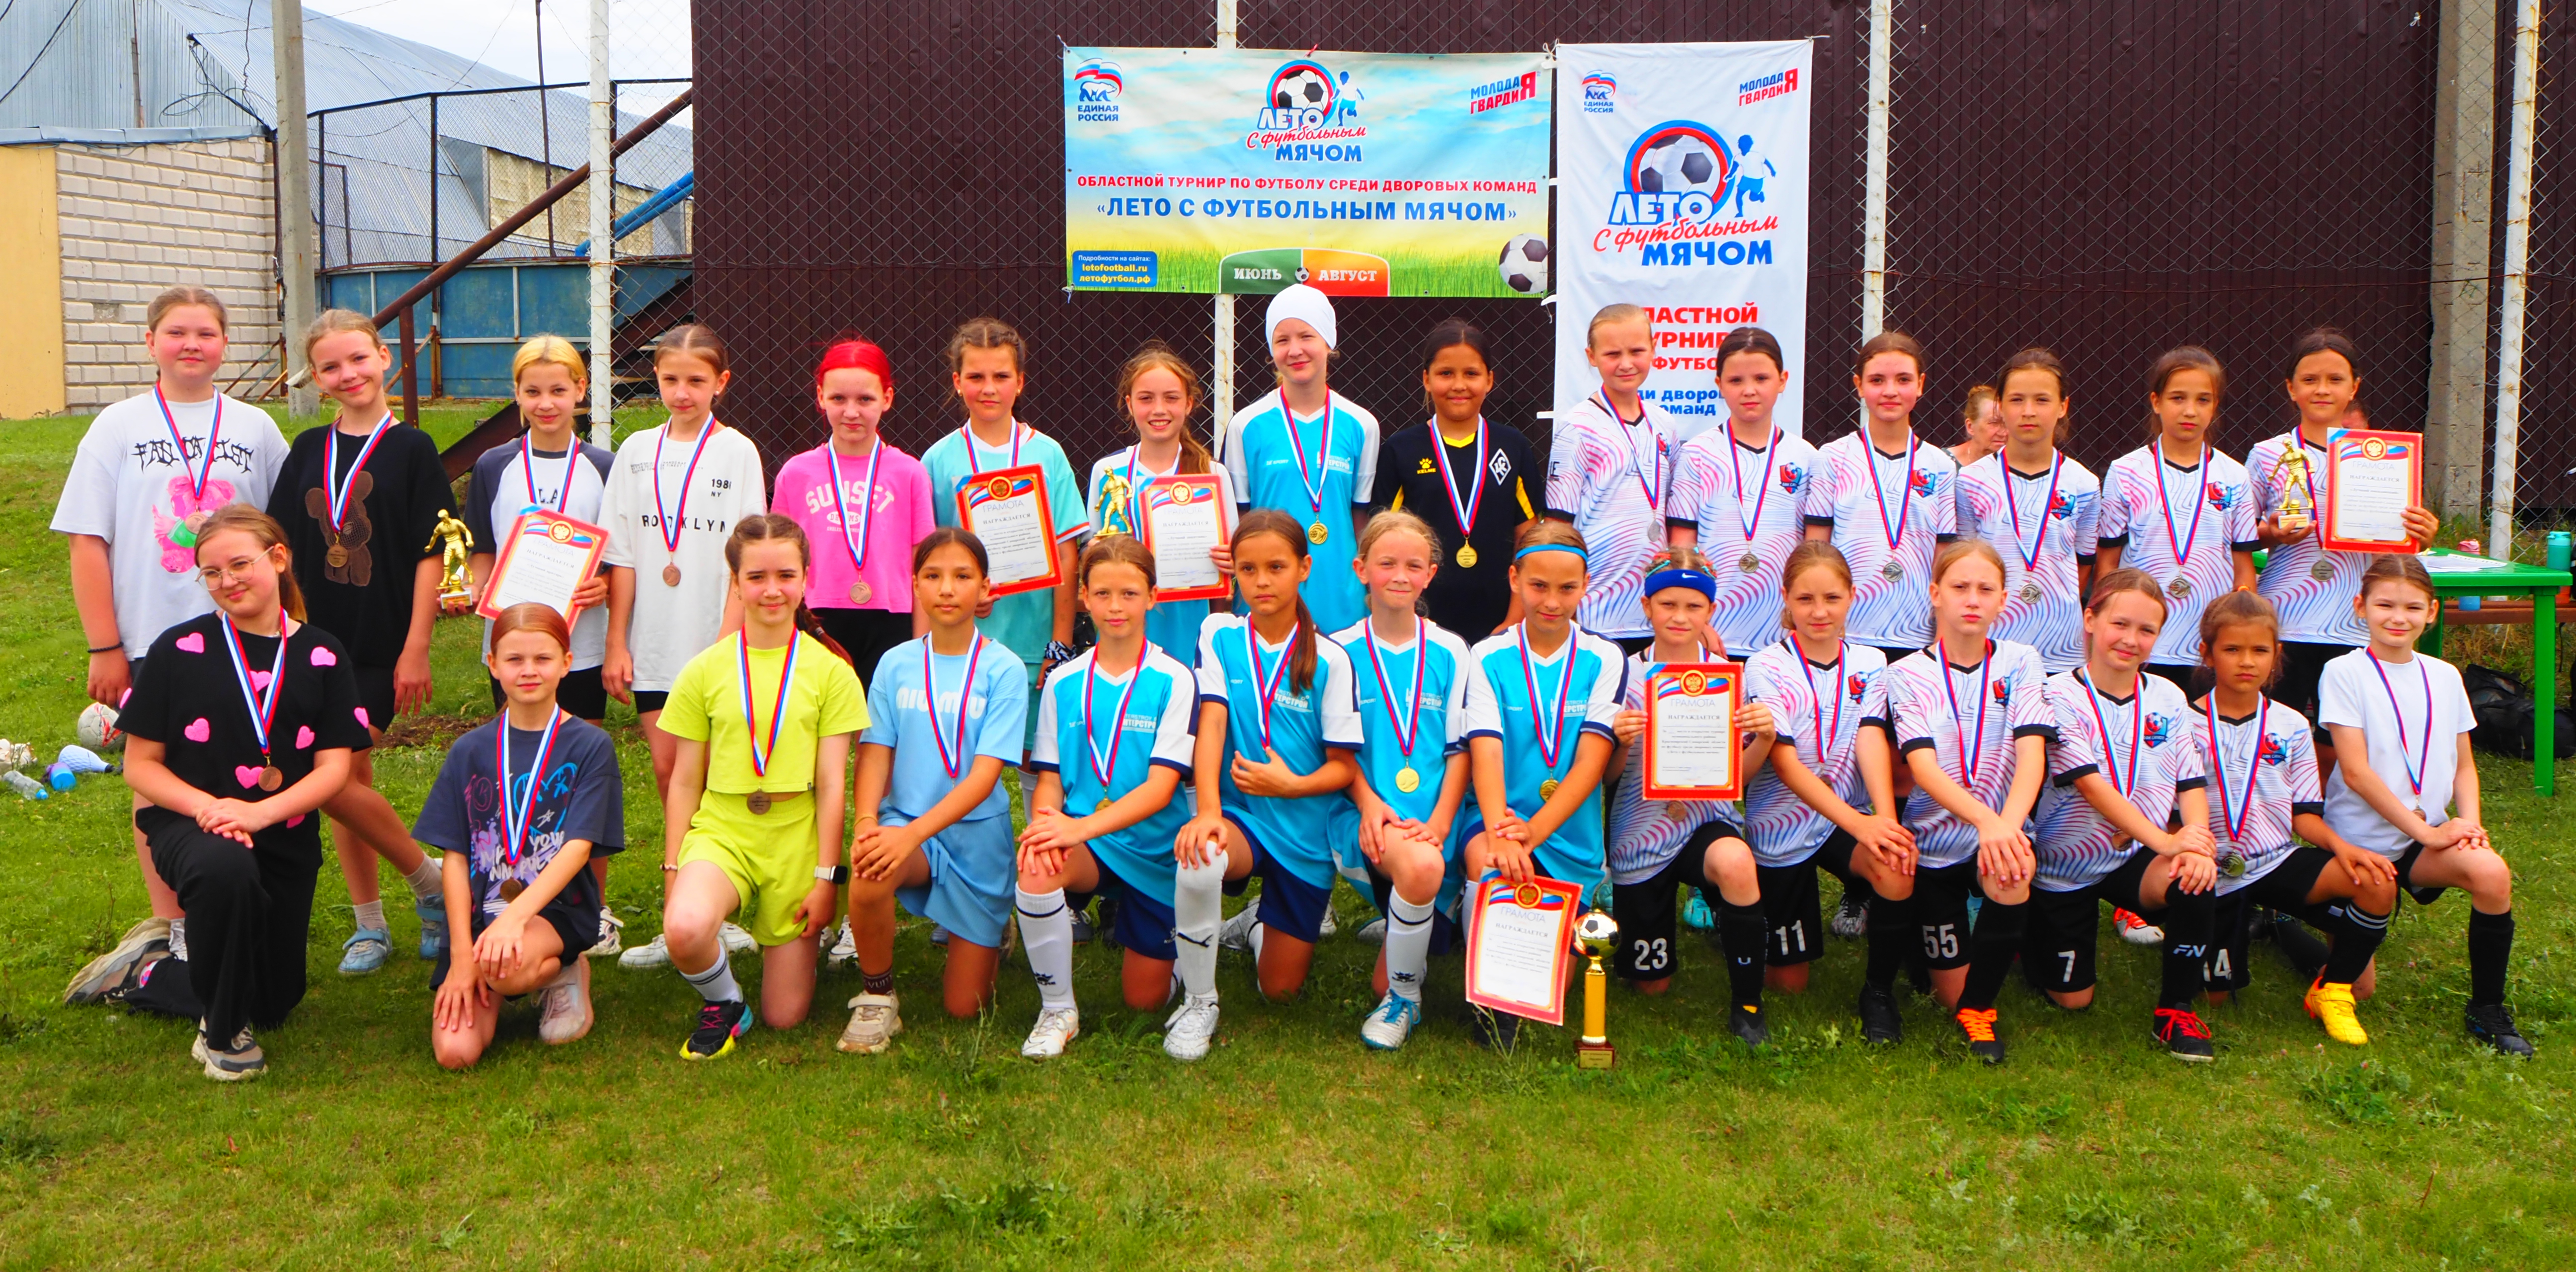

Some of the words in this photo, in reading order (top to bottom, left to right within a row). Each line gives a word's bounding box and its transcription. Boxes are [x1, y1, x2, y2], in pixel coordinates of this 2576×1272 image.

[1257, 107, 1325, 130] ЛЕТО
[1261, 126, 1367, 149] футбольным
[1275, 144, 1362, 161] МЯЧОМ
[1077, 173, 1164, 187] ОБЛАСТНОЙ
[1168, 176, 1226, 188] ТУРНИР
[1230, 178, 1250, 188] ПО
[1255, 178, 1325, 190] ФУТБОЛУ
[1329, 179, 1378, 192] СРЕДИ
[1382, 180, 1469, 192] ДВОРОВЫХ
[1473, 181, 1537, 194] КОМАНД
[1097, 198, 1171, 216] «ЛЕТО
[1179, 199, 1195, 216] С
[1203, 199, 1396, 220] ФУТБОЛЬНЫМ
[1405, 202, 1517, 221] МЯЧОМ»
[1608, 191, 1714, 226] ЛЕТО
[1614, 216, 1778, 253] футбольным
[1641, 240, 1772, 266] МЯЧОМ
[1079, 274, 1150, 284] летофутбол.рф
[1234, 268, 1282, 280] ИЮНЬ
[1318, 270, 1377, 281] АВГУСТ
[1641, 302, 1758, 323] ЛАСТНОЙ
[1652, 332, 1729, 348] УРНИР
[1652, 356, 1718, 370] ФУТБО
[1659, 403, 1716, 416] оманд
[2352, 461, 2395, 470] ГРАМОТА
[983, 500, 1024, 513] ГРАМОТА
[830, 514, 859, 522] DRMS
[983, 513, 1031, 524] НАГРАЖДАЕТСЯ
[1671, 699, 1715, 707] ГРАМОТА
[1501, 906, 1545, 923] ГРАМОТА
[1496, 923, 1548, 938] НАГРАЖДАЕТСЯ
[1775, 920, 1806, 955] 11
[1922, 923, 1958, 958] 55
[1634, 938, 1668, 970] 23
[2058, 950, 2076, 983] 7
